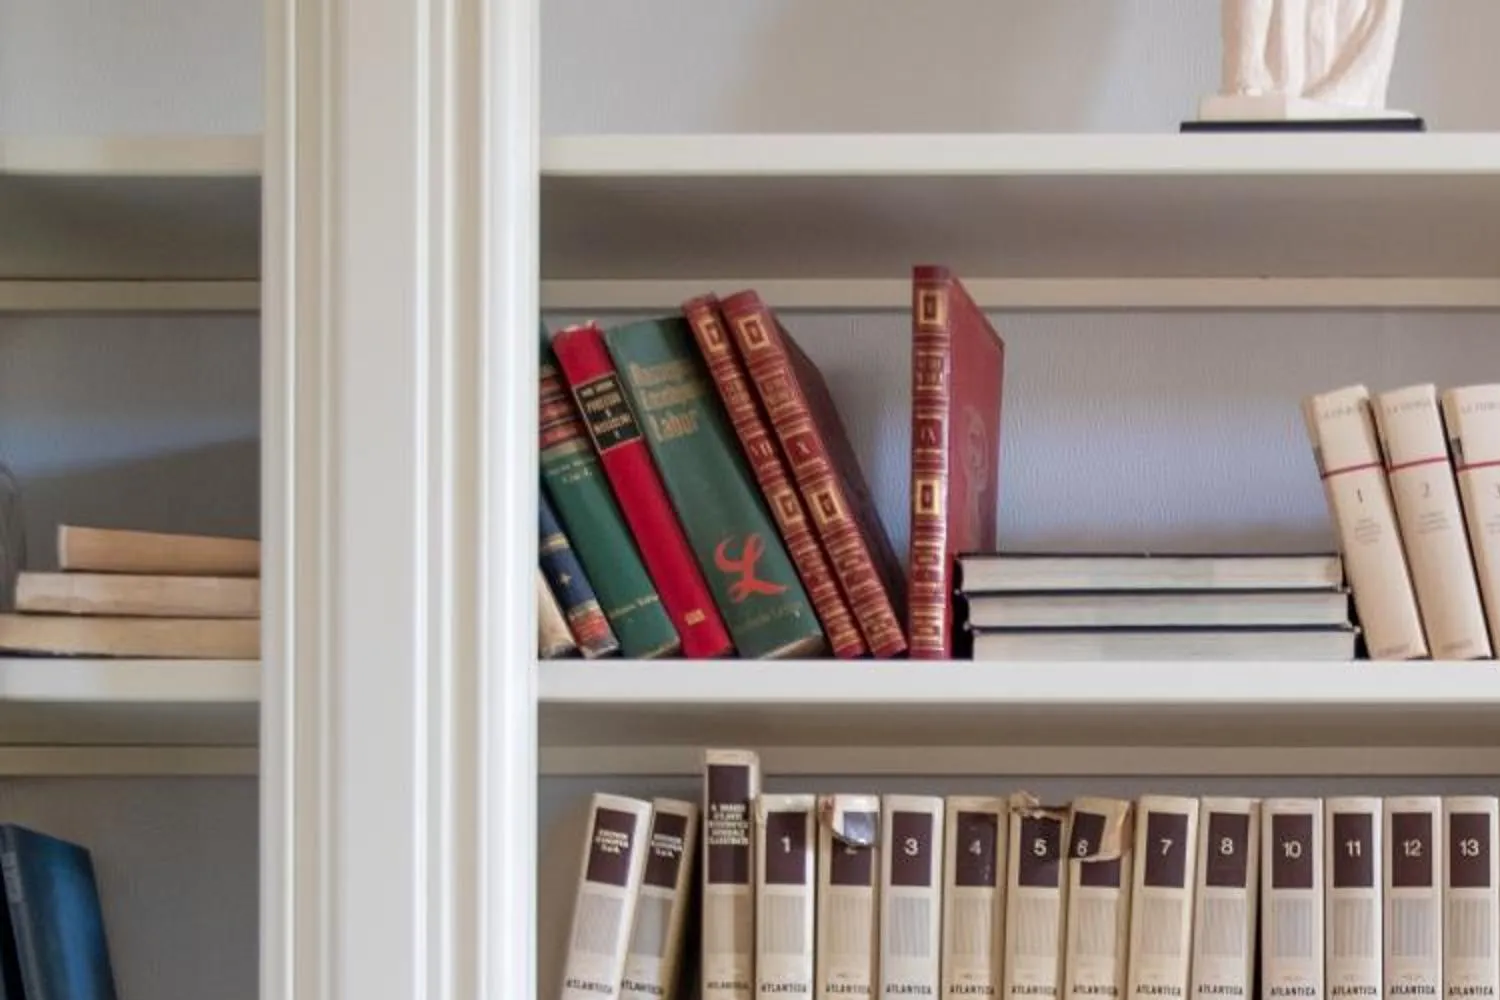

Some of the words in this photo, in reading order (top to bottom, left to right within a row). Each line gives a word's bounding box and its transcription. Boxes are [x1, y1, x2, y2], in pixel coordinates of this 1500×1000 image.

[781, 837, 790, 853] 1
[904, 838, 918, 855] 3
[969, 840, 981, 856] 4
[1034, 840, 1047, 855] 5
[1077, 841, 1087, 855] 6
[1161, 840, 1172, 855] 7
[1221, 839, 1234, 854] 8
[1284, 841, 1301, 857] 10
[1346, 840, 1361, 855] 11
[1403, 840, 1421, 856] 12
[1460, 840, 1478, 856] 13
